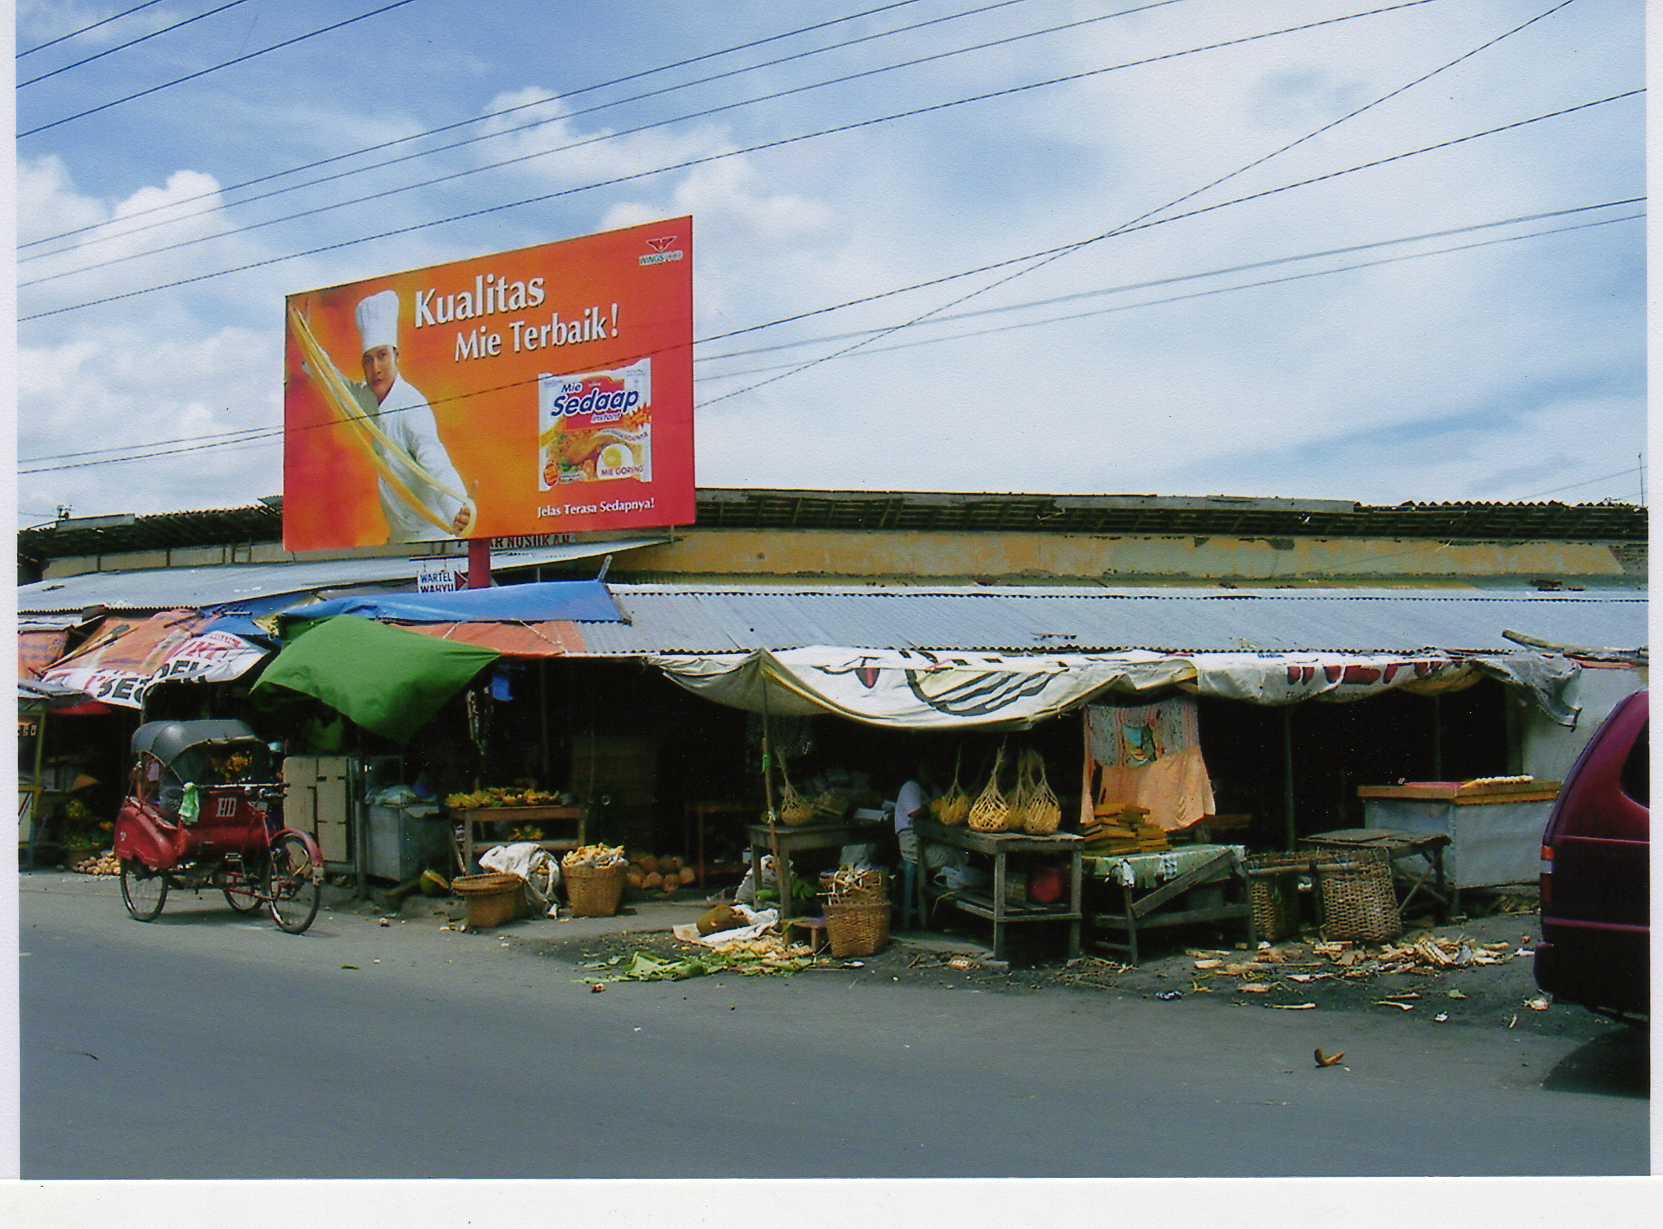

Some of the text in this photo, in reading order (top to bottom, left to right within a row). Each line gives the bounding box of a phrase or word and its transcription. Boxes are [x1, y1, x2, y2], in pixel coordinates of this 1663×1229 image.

[414, 273, 546, 328] Kualitas
[454, 303, 619, 362] Mie Terbaik!
[560, 381, 583, 394] Mie
[551, 387, 640, 417] Sedaap
[537, 497, 655, 518] Jelas Terasa Sedapnya!
[420, 572, 453, 583] WARTEL
